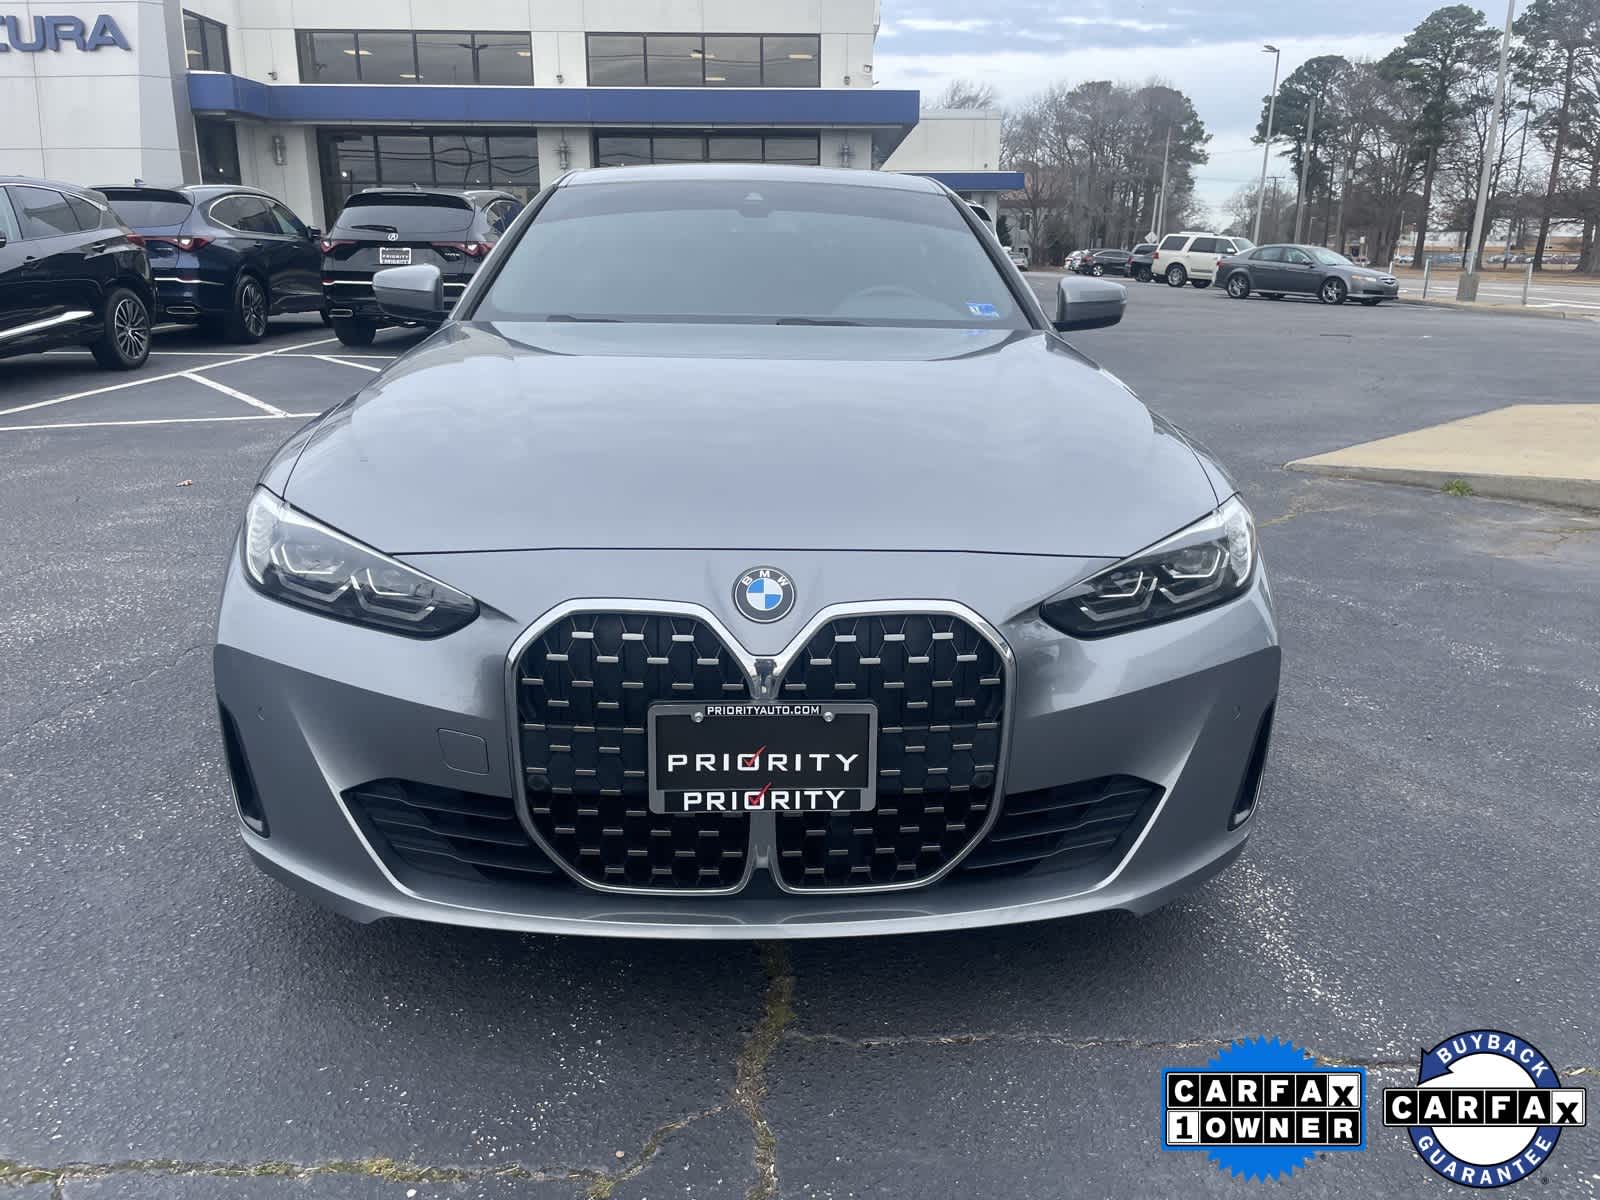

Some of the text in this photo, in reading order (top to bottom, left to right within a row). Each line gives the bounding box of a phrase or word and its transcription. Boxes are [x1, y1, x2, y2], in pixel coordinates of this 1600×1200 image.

[741, 570, 789, 586] BMW
[707, 706, 820, 715] PRIORITYAUTO.COM
[667, 753, 859, 772] PRIORITY
[683, 790, 846, 811] PRIORITY
